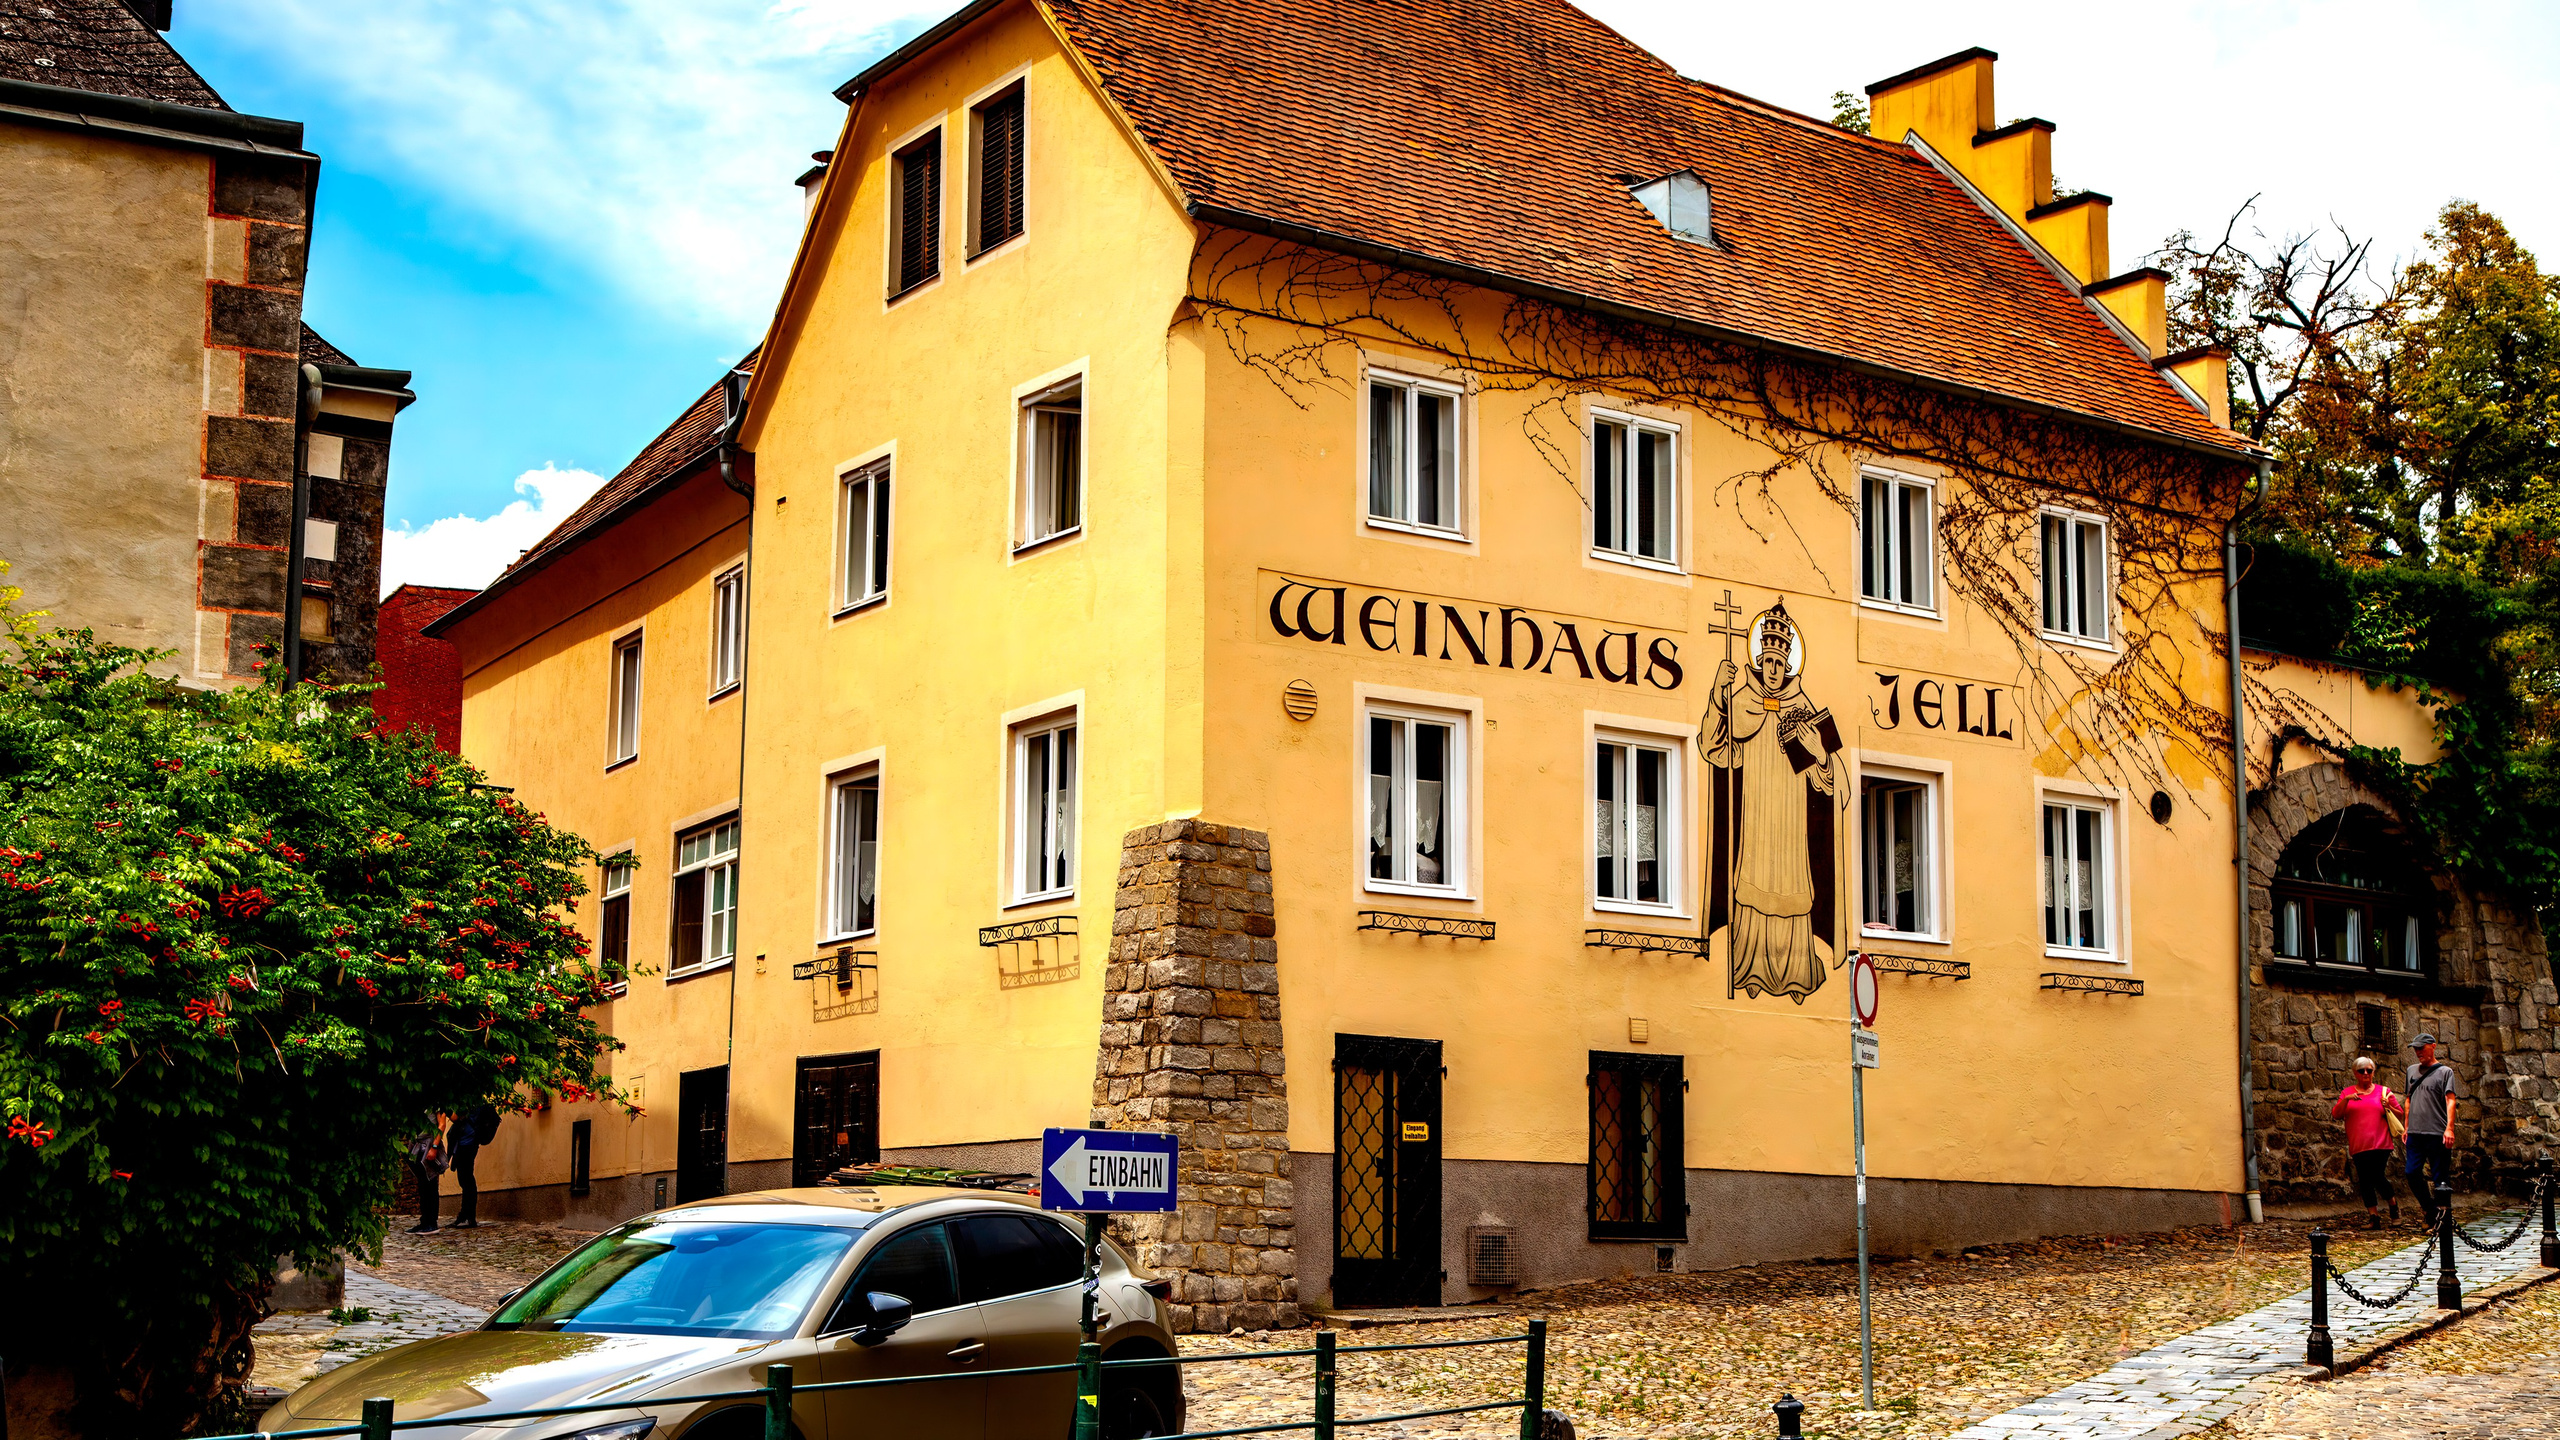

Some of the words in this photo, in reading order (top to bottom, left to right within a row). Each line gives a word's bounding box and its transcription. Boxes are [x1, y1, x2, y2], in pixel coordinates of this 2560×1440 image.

[1269, 576, 1683, 690] WEINHAUS
[1868, 672, 2013, 741] JELL
[1089, 1155, 1163, 1189] EINBAHN
